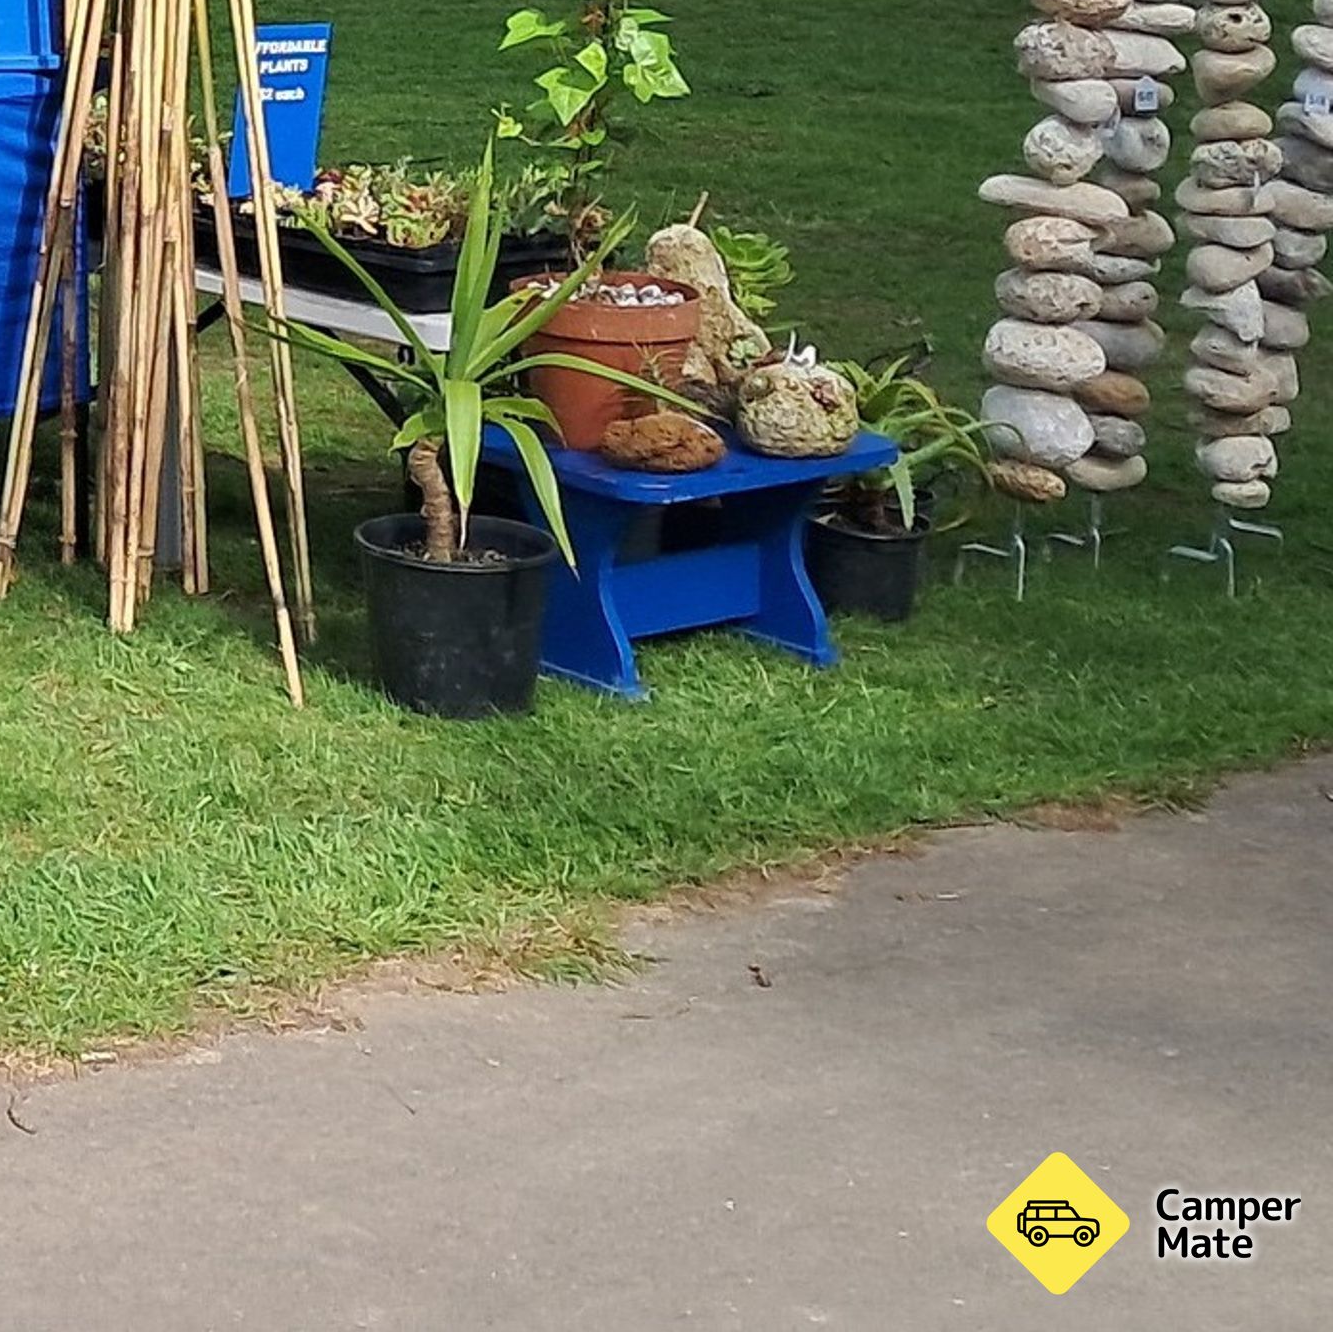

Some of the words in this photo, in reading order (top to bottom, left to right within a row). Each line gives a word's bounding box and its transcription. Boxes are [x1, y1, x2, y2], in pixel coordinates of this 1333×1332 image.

[255, 39, 328, 54] FFORDABLE
[259, 58, 309, 74] PLANTS
[275, 86, 305, 101] each
